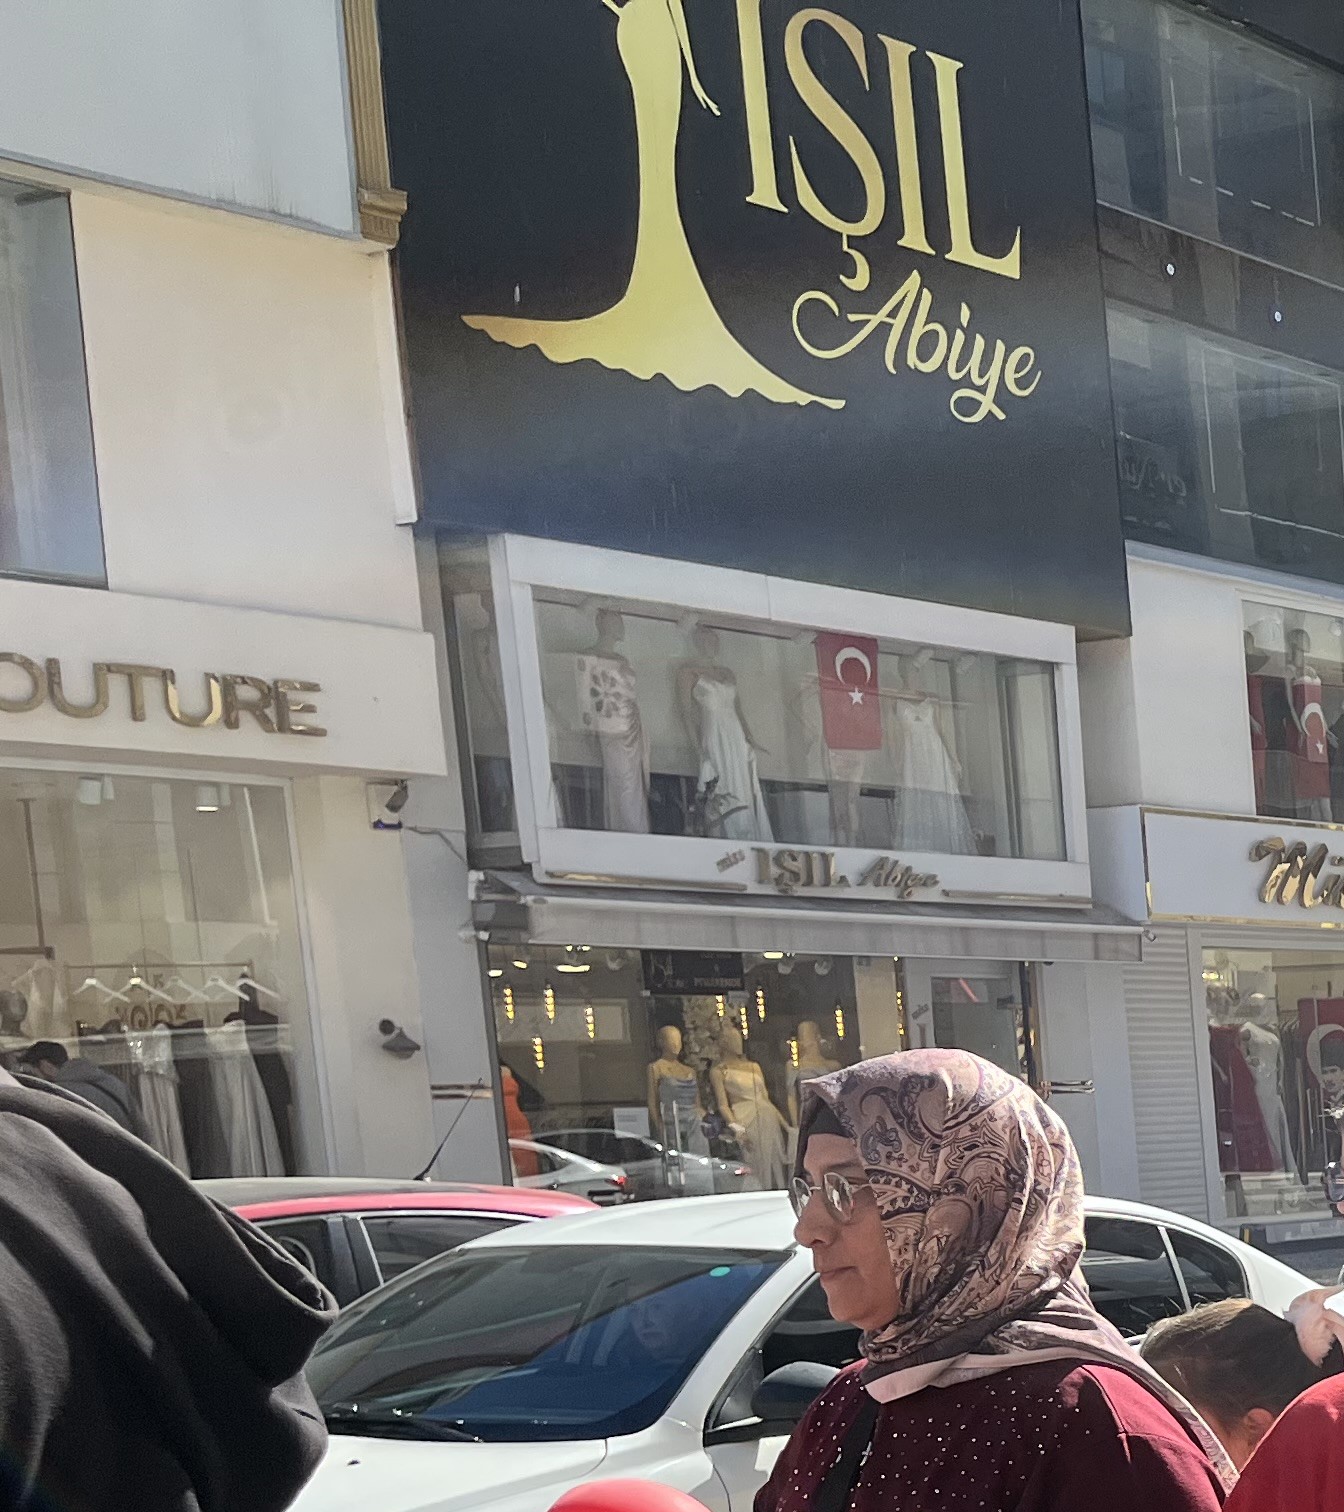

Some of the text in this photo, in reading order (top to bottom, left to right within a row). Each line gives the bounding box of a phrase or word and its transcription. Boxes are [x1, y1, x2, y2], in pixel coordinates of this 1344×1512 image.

[737, 0, 1021, 290] IŞIL
[793, 270, 1042, 422] Abiye
[0, 652, 327, 737] OUTURE
